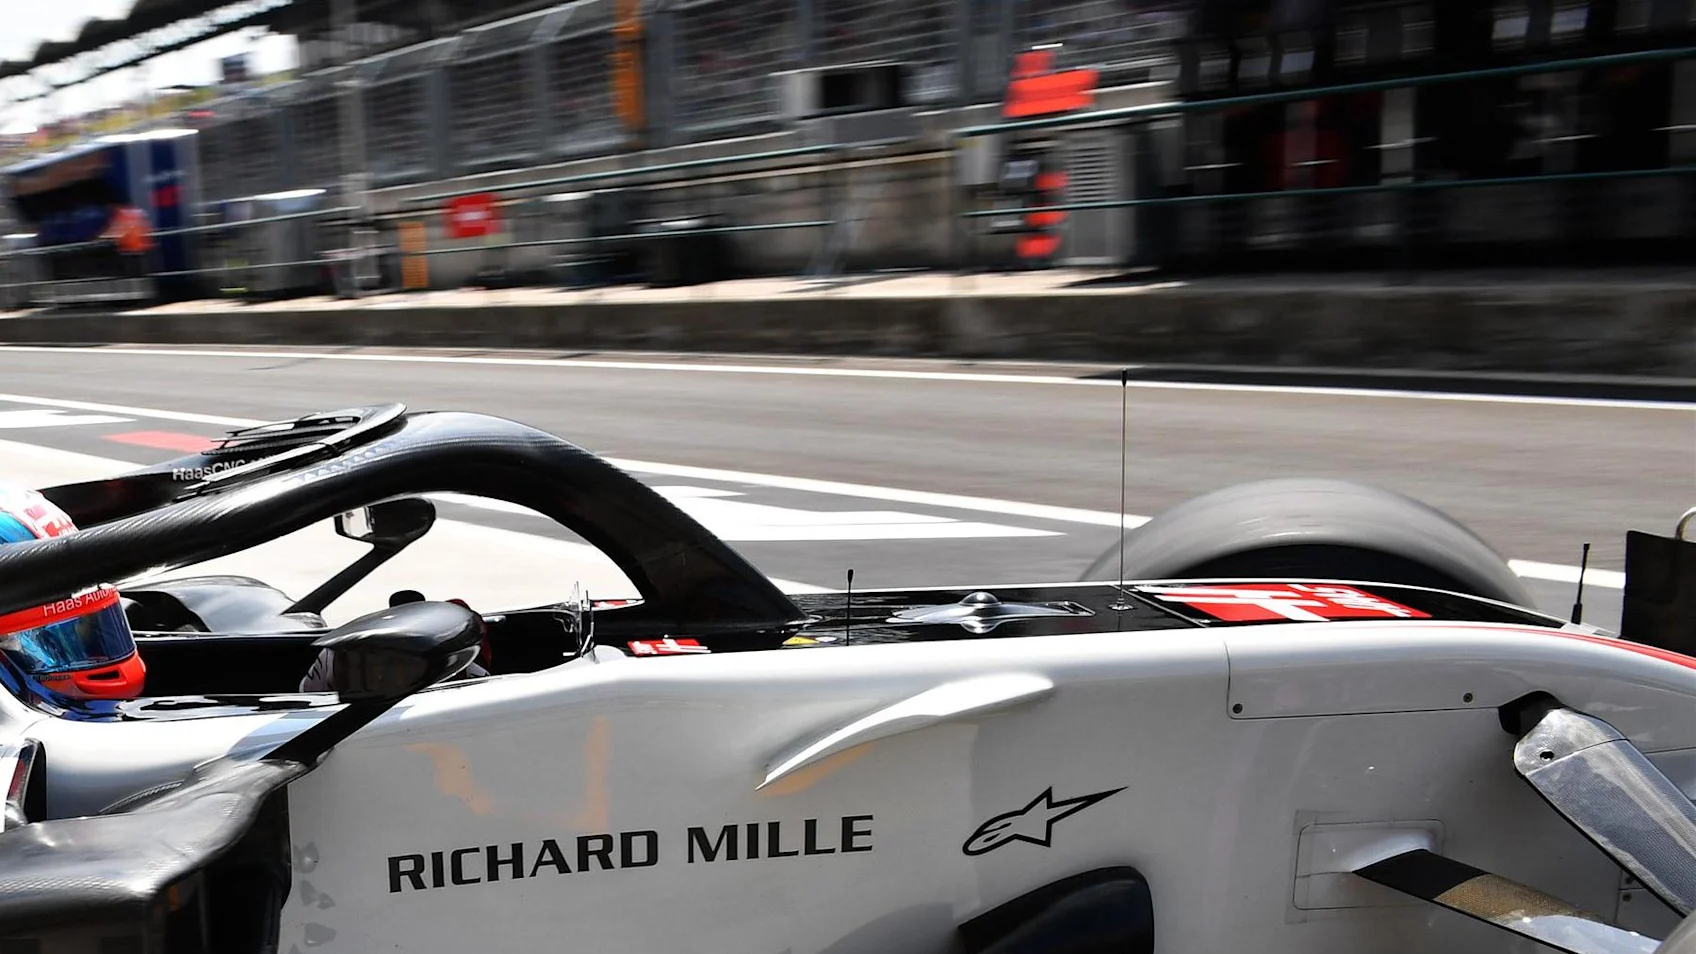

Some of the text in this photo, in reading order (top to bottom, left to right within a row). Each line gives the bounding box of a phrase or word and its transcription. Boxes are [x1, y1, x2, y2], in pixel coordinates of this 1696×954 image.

[43, 597, 83, 617] Haas
[387, 814, 874, 894] RICHARD MILLE
